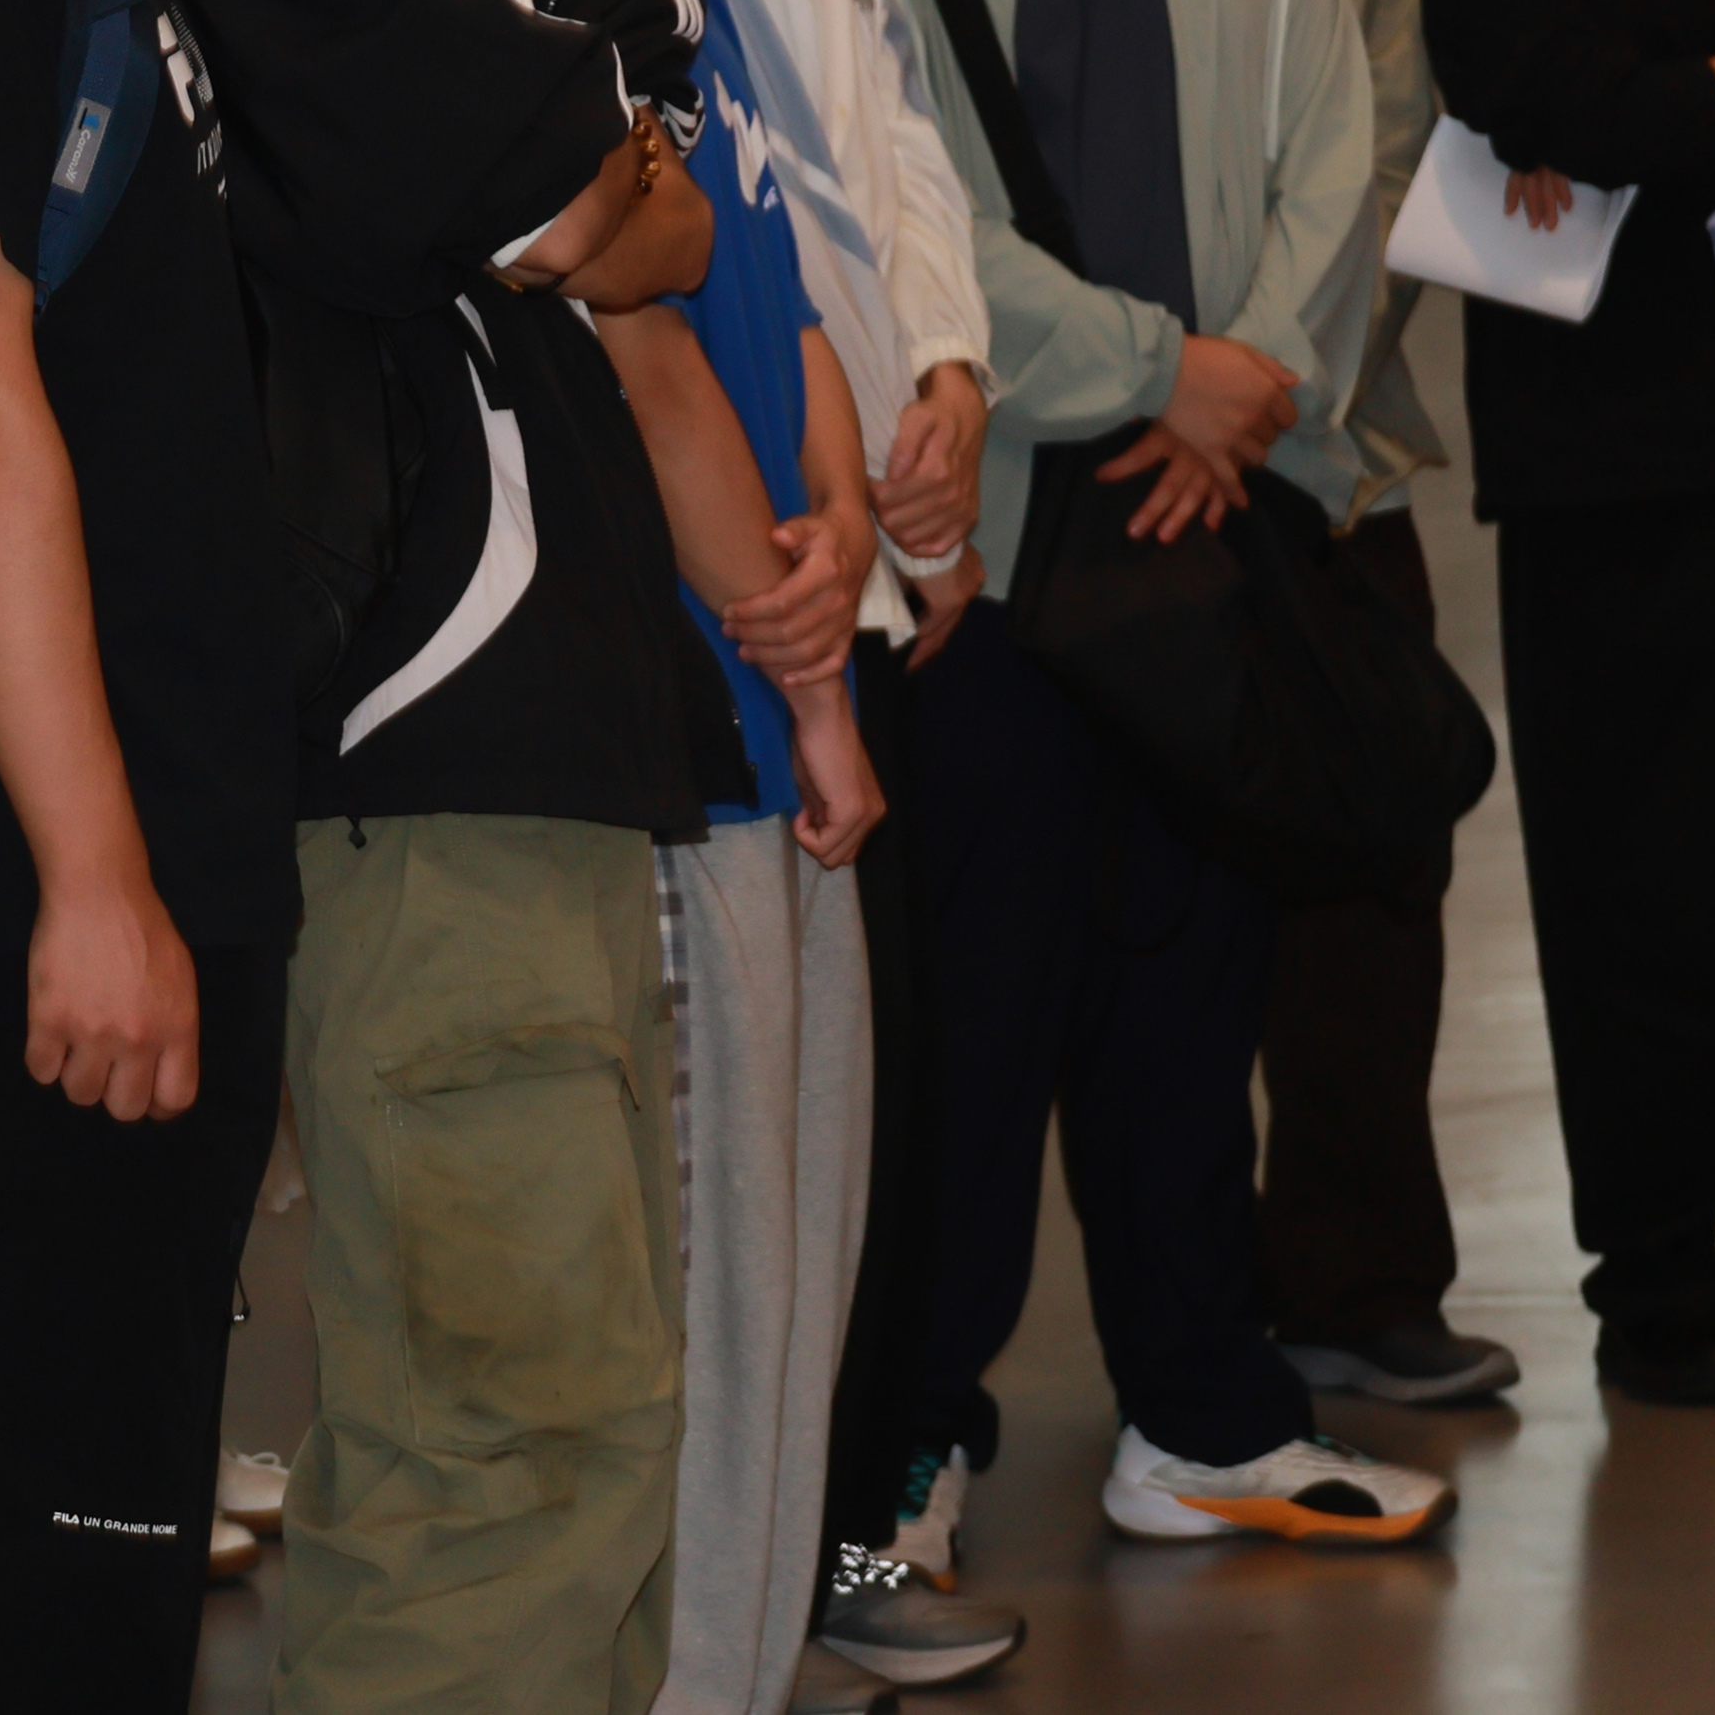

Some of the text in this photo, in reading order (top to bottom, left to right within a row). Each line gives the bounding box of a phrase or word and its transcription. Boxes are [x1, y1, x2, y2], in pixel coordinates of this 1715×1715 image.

[53, 1512, 178, 1535] FILA UN GRANDE NOME
